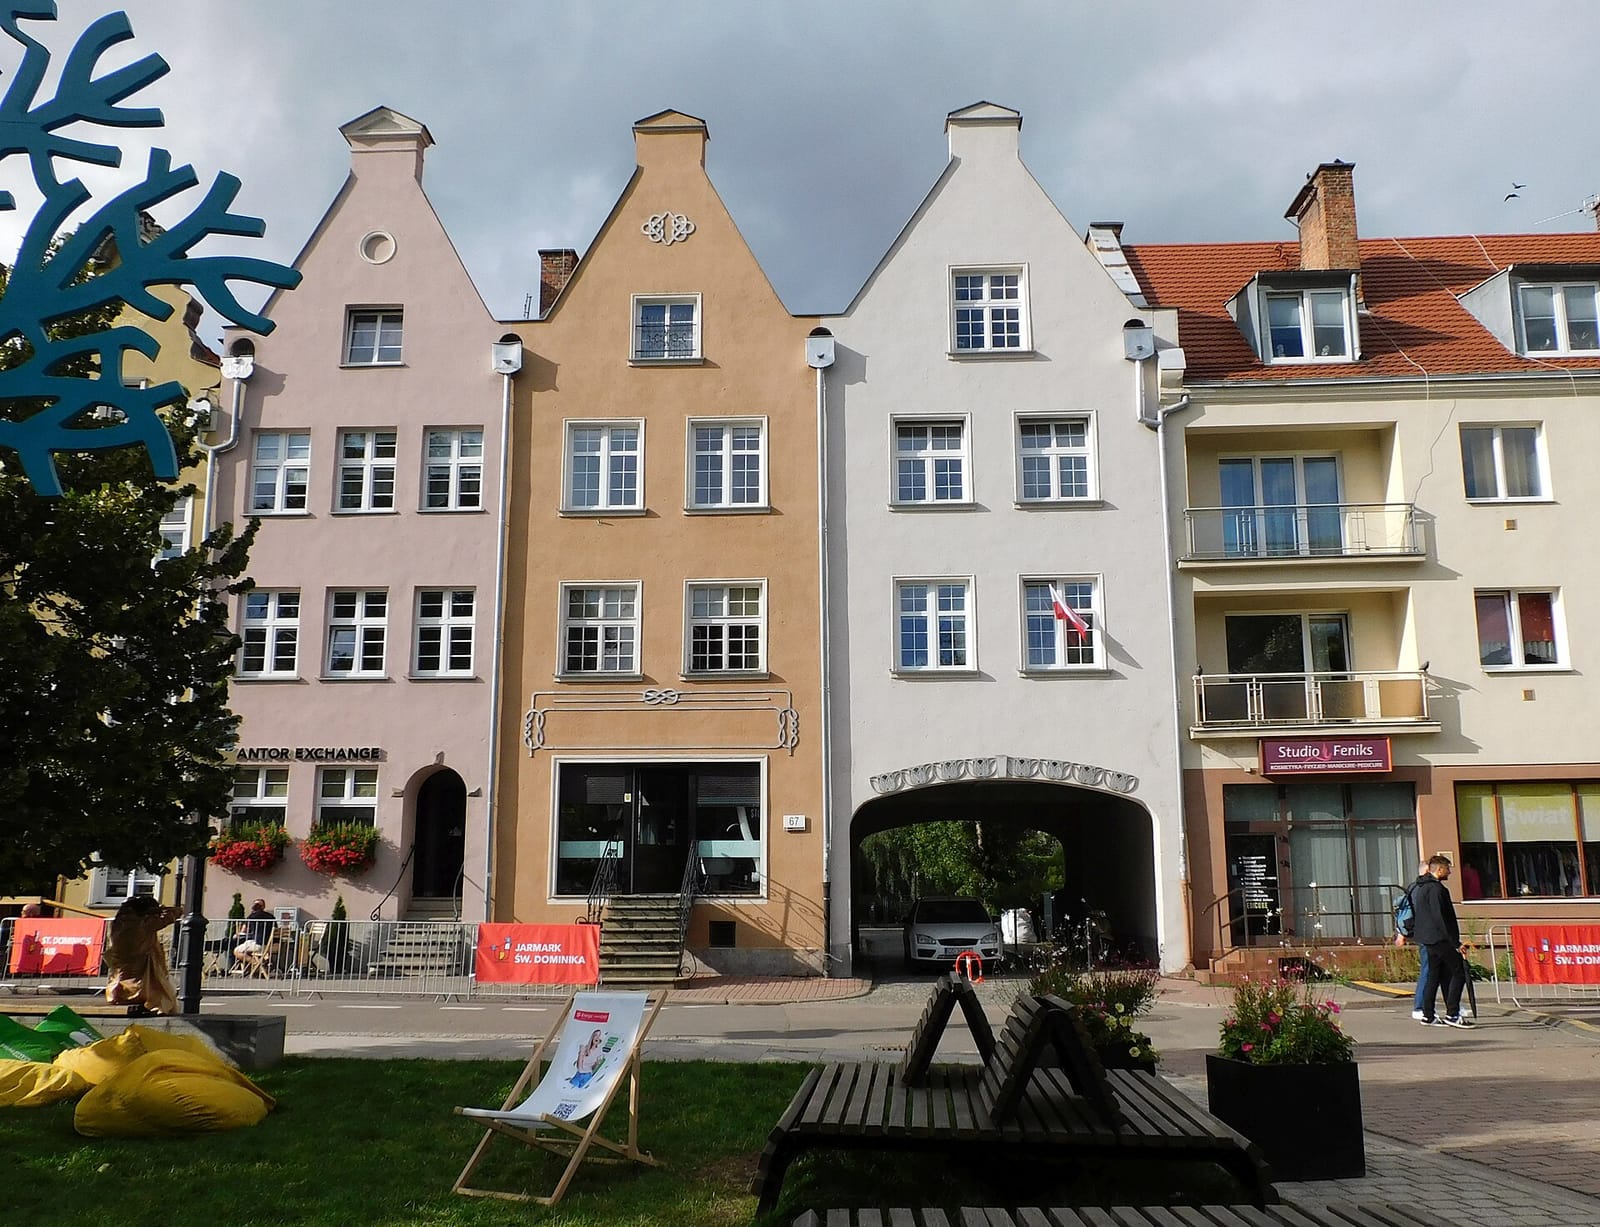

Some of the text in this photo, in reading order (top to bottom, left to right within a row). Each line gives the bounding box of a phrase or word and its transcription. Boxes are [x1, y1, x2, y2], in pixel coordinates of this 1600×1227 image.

[237, 747, 380, 759] ANTOR EXCHANGE
[1278, 744, 1373, 758] Studio Feniks
[788, 816, 800, 826] 67
[514, 943, 562, 953] JARMARK
[514, 952, 586, 965] ŚW. DOMINIKA
[1554, 954, 1575, 965] ŚW.
